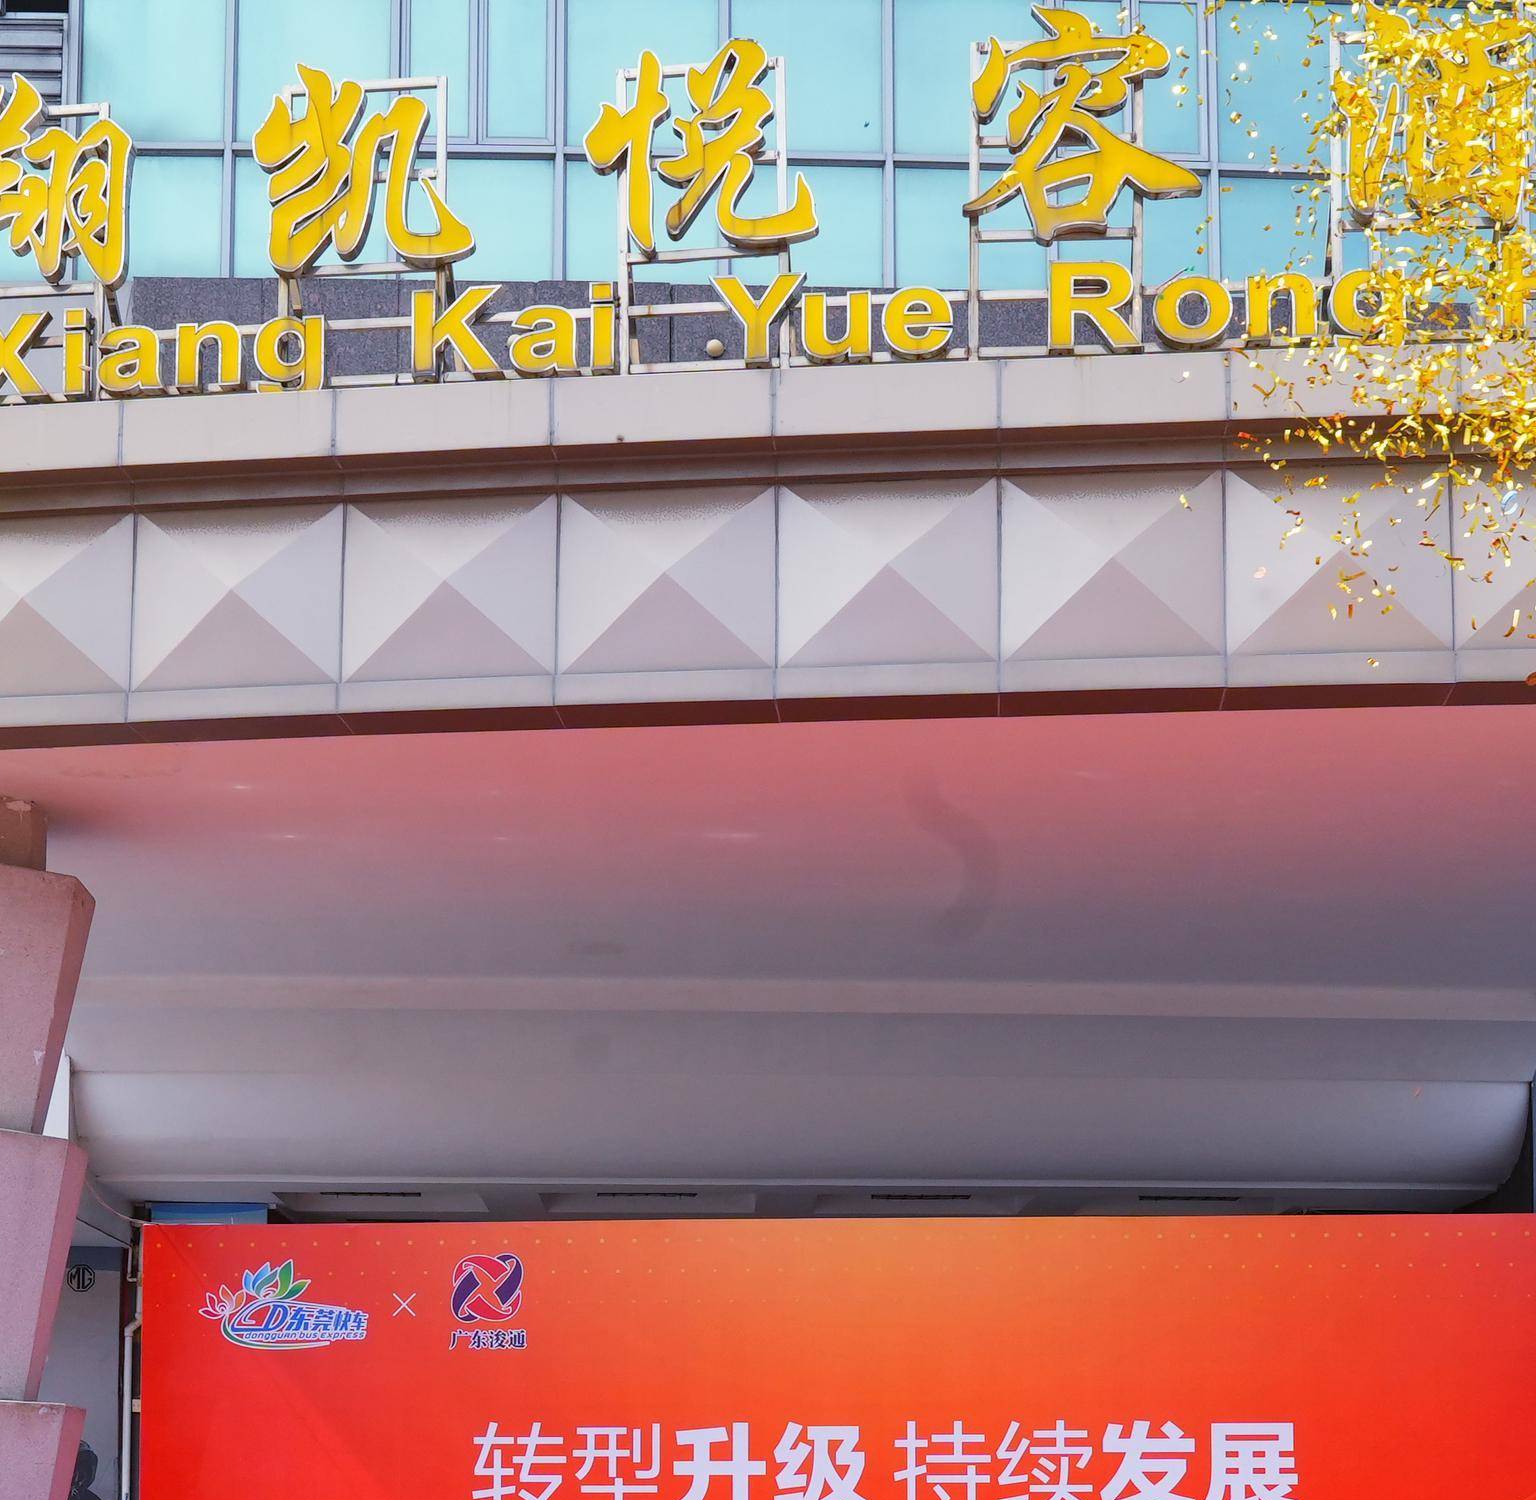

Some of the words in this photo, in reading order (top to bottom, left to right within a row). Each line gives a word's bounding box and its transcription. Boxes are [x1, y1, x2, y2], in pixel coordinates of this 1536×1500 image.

[411, 280, 618, 382] Kai
[709, 270, 954, 367] Yue
[1047, 259, 1405, 354] Rong
[449, 1329, 528, 1350] 广东浚通
